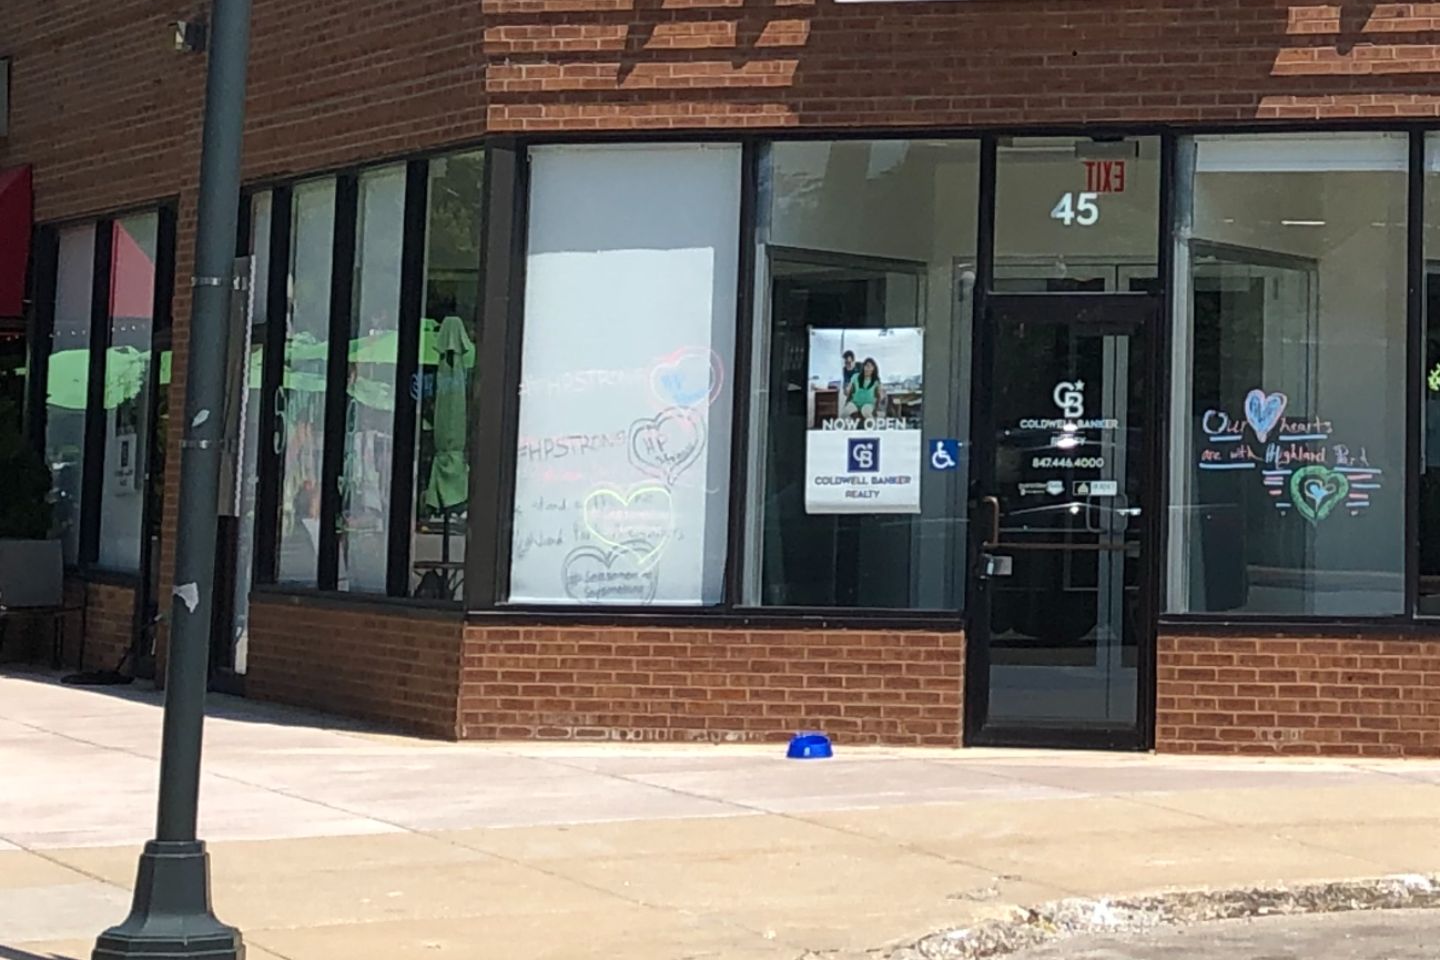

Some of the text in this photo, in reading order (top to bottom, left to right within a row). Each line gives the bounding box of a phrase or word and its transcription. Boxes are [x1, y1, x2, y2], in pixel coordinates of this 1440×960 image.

[1051, 192, 1099, 226] 45
[1053, 381, 1084, 418] CB
[822, 417, 907, 430] NOW OPEN
[1077, 419, 1119, 429] BANKER
[1279, 416, 1333, 433] hearts
[814, 475, 911, 486] COLDWELL BANKER
[845, 489, 880, 499] REALTY
